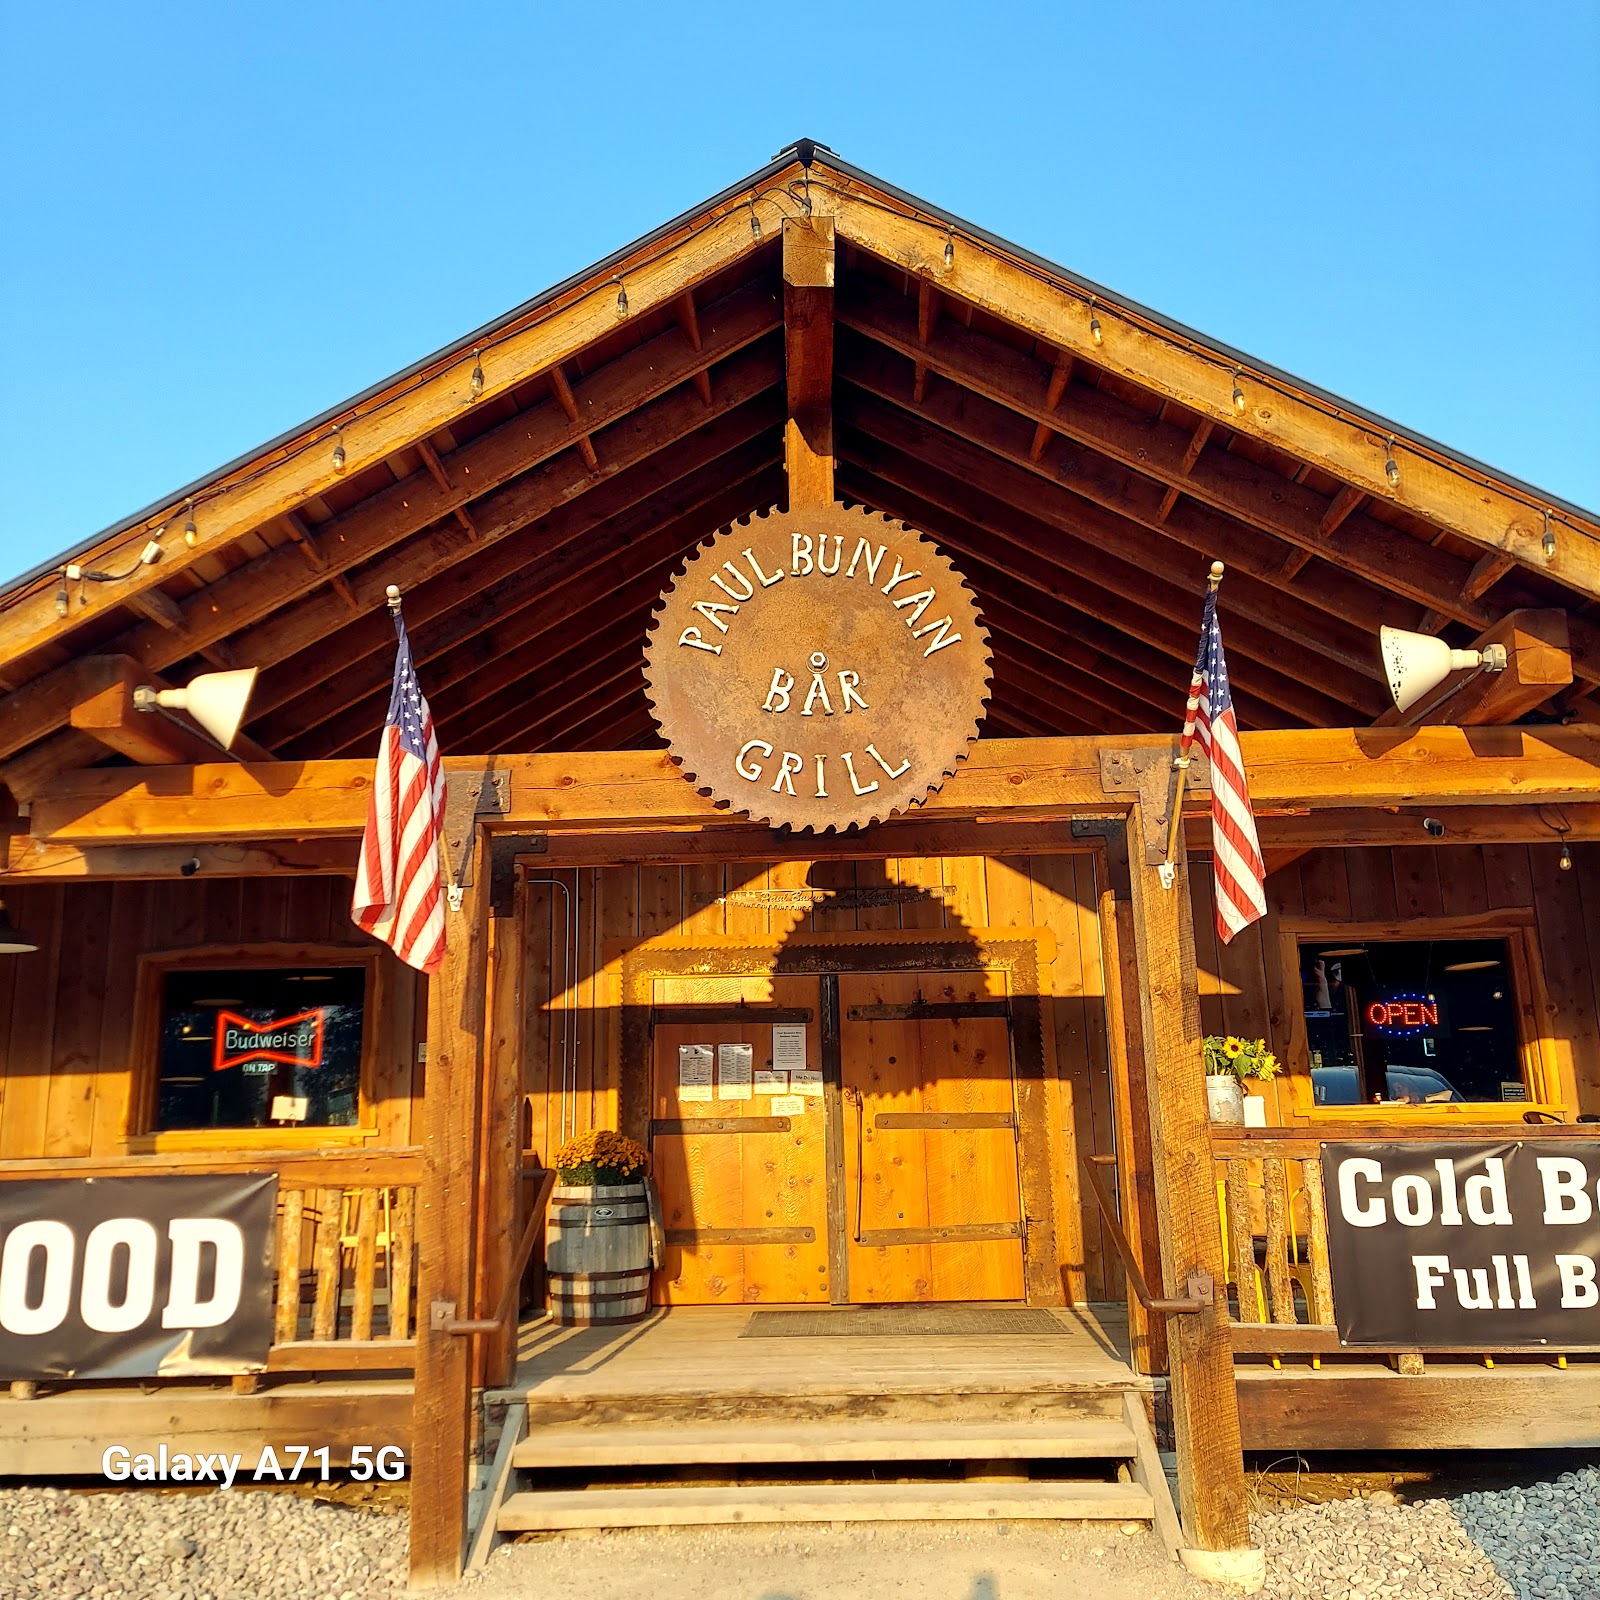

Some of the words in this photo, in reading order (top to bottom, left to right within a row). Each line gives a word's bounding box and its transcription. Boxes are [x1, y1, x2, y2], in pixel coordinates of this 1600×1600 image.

[678, 547, 785, 656] PAUL
[790, 532, 963, 658] BUNYAN
[761, 667, 870, 717] BAR
[734, 739, 912, 798] GRILL
[225, 1029, 316, 1050] Budweiser
[1369, 1002, 1439, 1026] OPEN
[257, 1063, 276, 1073] TAP
[1337, 1157, 1513, 1228] Cold
[1536, 1156, 1600, 1226] B
[0, 1218, 244, 1335] OOD
[1411, 1255, 1537, 1310] Full
[1554, 1254, 1599, 1309] B
